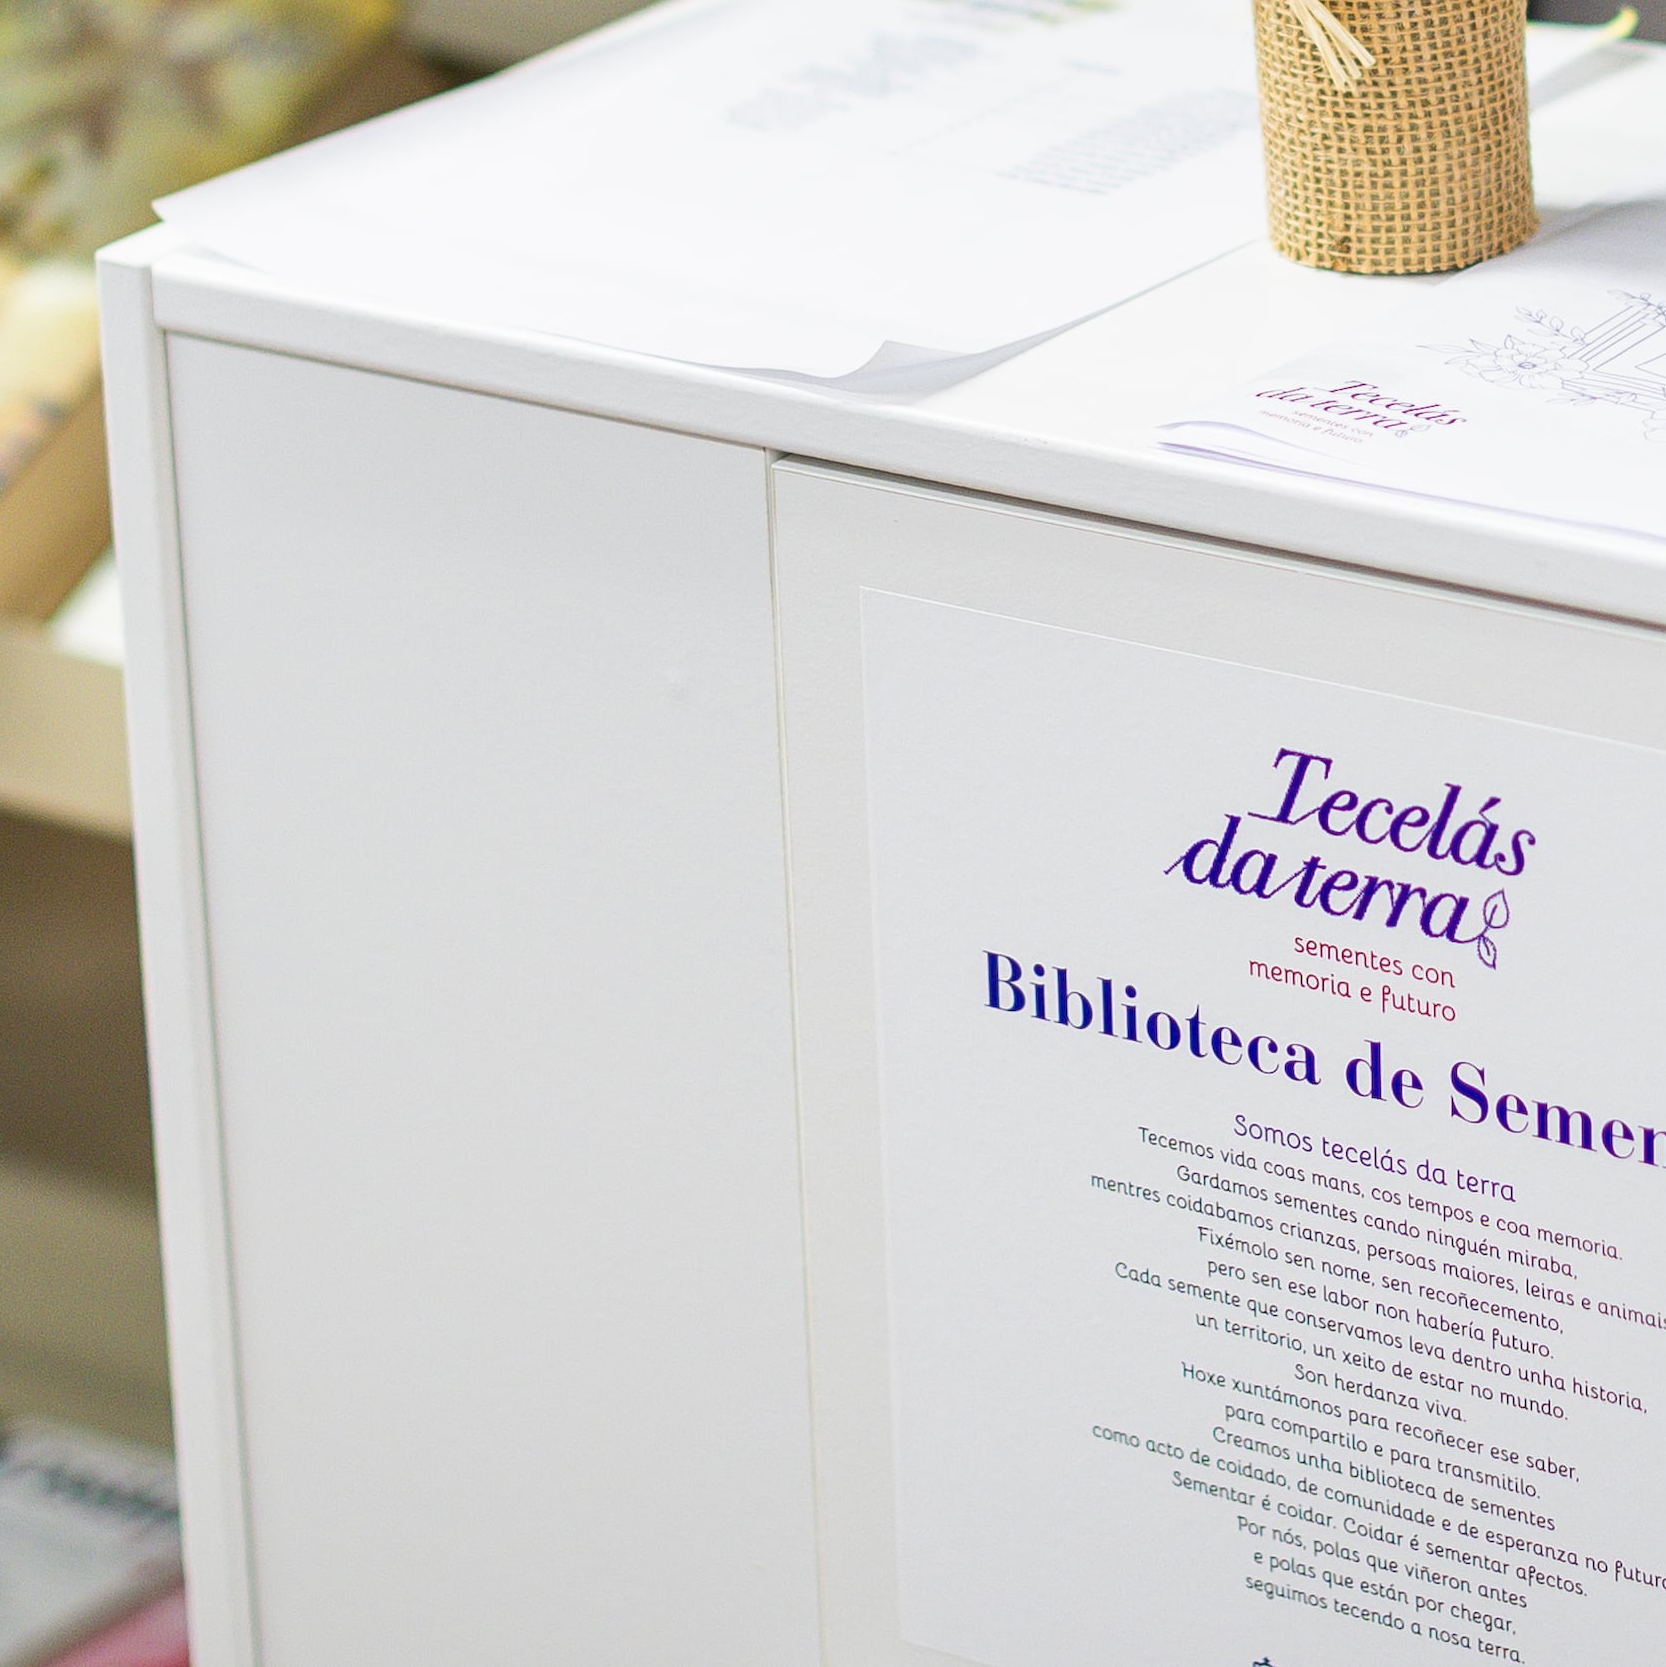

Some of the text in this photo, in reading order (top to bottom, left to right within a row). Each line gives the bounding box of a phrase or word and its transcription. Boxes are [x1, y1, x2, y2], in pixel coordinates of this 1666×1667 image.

[1255, 386, 1409, 430] da terra
[1313, 379, 1467, 426] Tecelás
[1248, 747, 1536, 876] Tecelás
[1164, 813, 1485, 944] da terra
[1248, 959, 1457, 1022] memoria e futuro
[1293, 936, 1456, 989] sementes con
[981, 949, 1322, 1086] Biblioteca
[1345, 1038, 1425, 1109] de
[1137, 1126, 1623, 1261] Tecemos vida coas mans, cos tempos e coa memoria.
[1233, 1113, 1517, 1203] Somos tecelás da terra
[1090, 1174, 1161, 1204] mentres
[1166, 1193, 1274, 1232] coidabamos
[1279, 1221, 1361, 1255] crianzas,
[1366, 1243, 1437, 1272] persoas
[1442, 1262, 1519, 1295] maiores,
[1525, 1277, 1575, 1307] leiras
[1580, 1297, 1592, 1311] e
[1176, 1164, 1578, 1281] Gardamos sementes cando ninguén miraba,
[1196, 1225, 1564, 1335] Fixémolo sen nome, sen recoñecemento,
[1207, 1260, 1555, 1360] pero sen ese labor non habería futuro.
[1114, 1261, 1648, 1415] Cada semente que conservamos leva dentro unha historia,
[1195, 1313, 1569, 1421] un territorio, un xeito de estar no mundo.
[1180, 1360, 1580, 1483] Hoxe xuntámonos para recoñecer ese saber,
[1293, 1363, 1467, 1423] Son herdanza viva.
[1092, 1425, 1141, 1448] como
[1145, 1439, 1185, 1460] acto
[1189, 1447, 1211, 1468] de
[1216, 1458, 1291, 1491] coidado,
[1296, 1476, 1318, 1496] de
[1323, 1486, 1436, 1528] comunidade
[1441, 1518, 1452, 1532] e
[1457, 1519, 1479, 1540] de
[1485, 1530, 1579, 1567] esperanza
[1584, 1556, 1609, 1574] no
[1212, 1425, 1556, 1532] Creamos unha biblioteca de sementes
[1224, 1404, 1541, 1500] para compartilo e para transmitilo.
[1171, 1470, 1588, 1597] Sementar é coidar. Coidar é sementar afectos.
[1236, 1515, 1528, 1609] Por nós, polas que viñeron antes
[1245, 1576, 1526, 1665] seguimos tecendo a nosa terra.
[1253, 1551, 1517, 1636] e polas que están por chegar,
